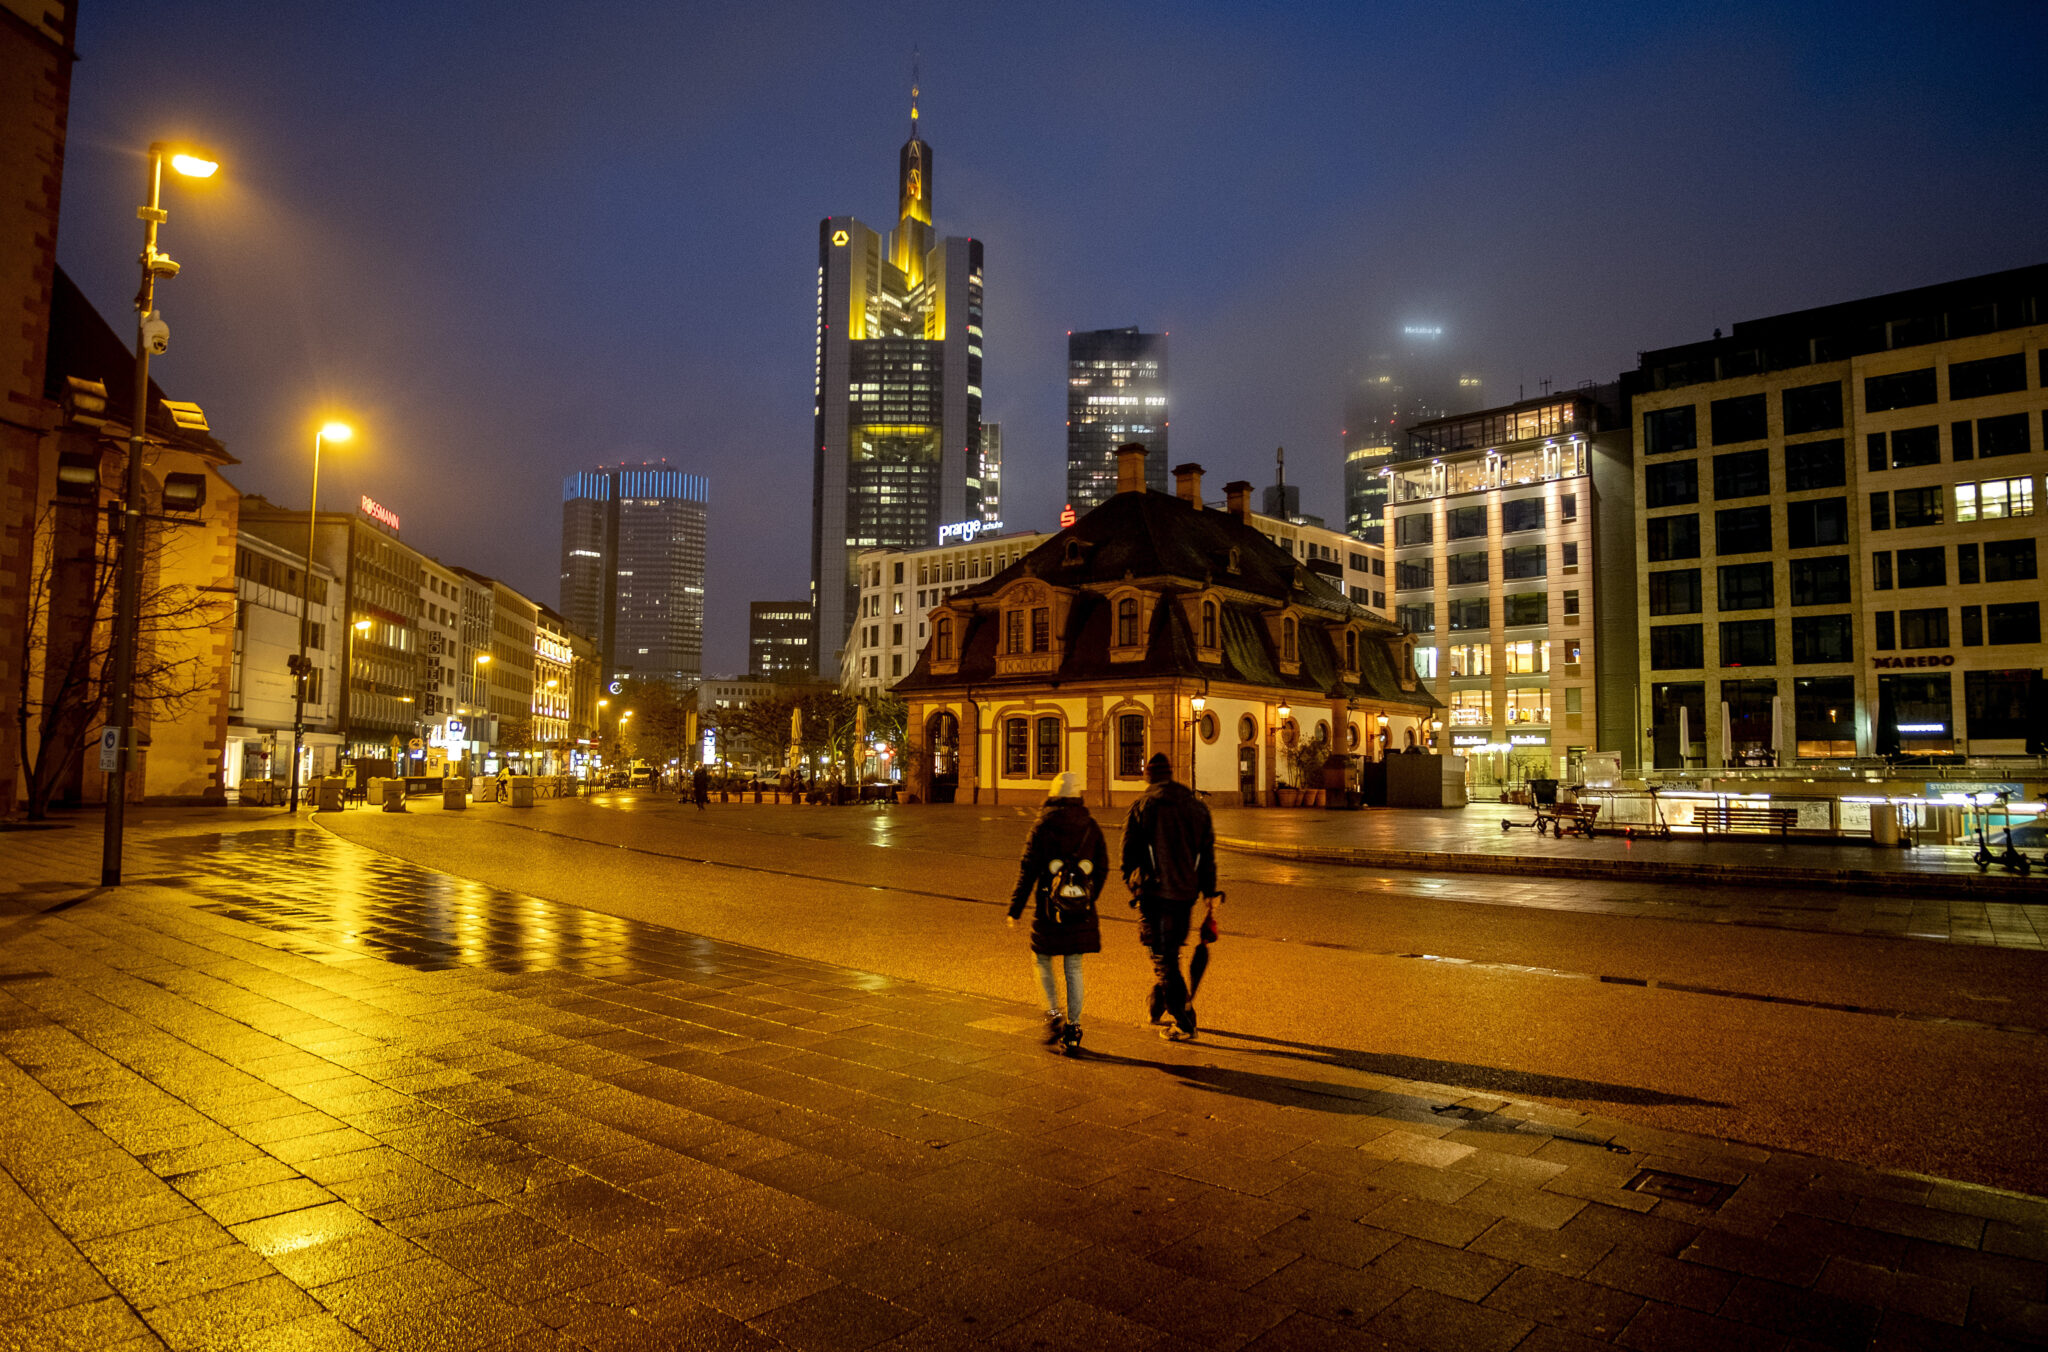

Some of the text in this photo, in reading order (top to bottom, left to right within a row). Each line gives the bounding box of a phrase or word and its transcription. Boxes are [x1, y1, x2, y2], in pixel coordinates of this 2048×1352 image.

[361, 495, 399, 530] ROSSMANN
[939, 520, 1003, 545] prange schuhe
[427, 631, 441, 692] HOTEL
[1872, 655, 1955, 669] MAREDO
[1930, 783, 1987, 791] STADTPOLIZEI
